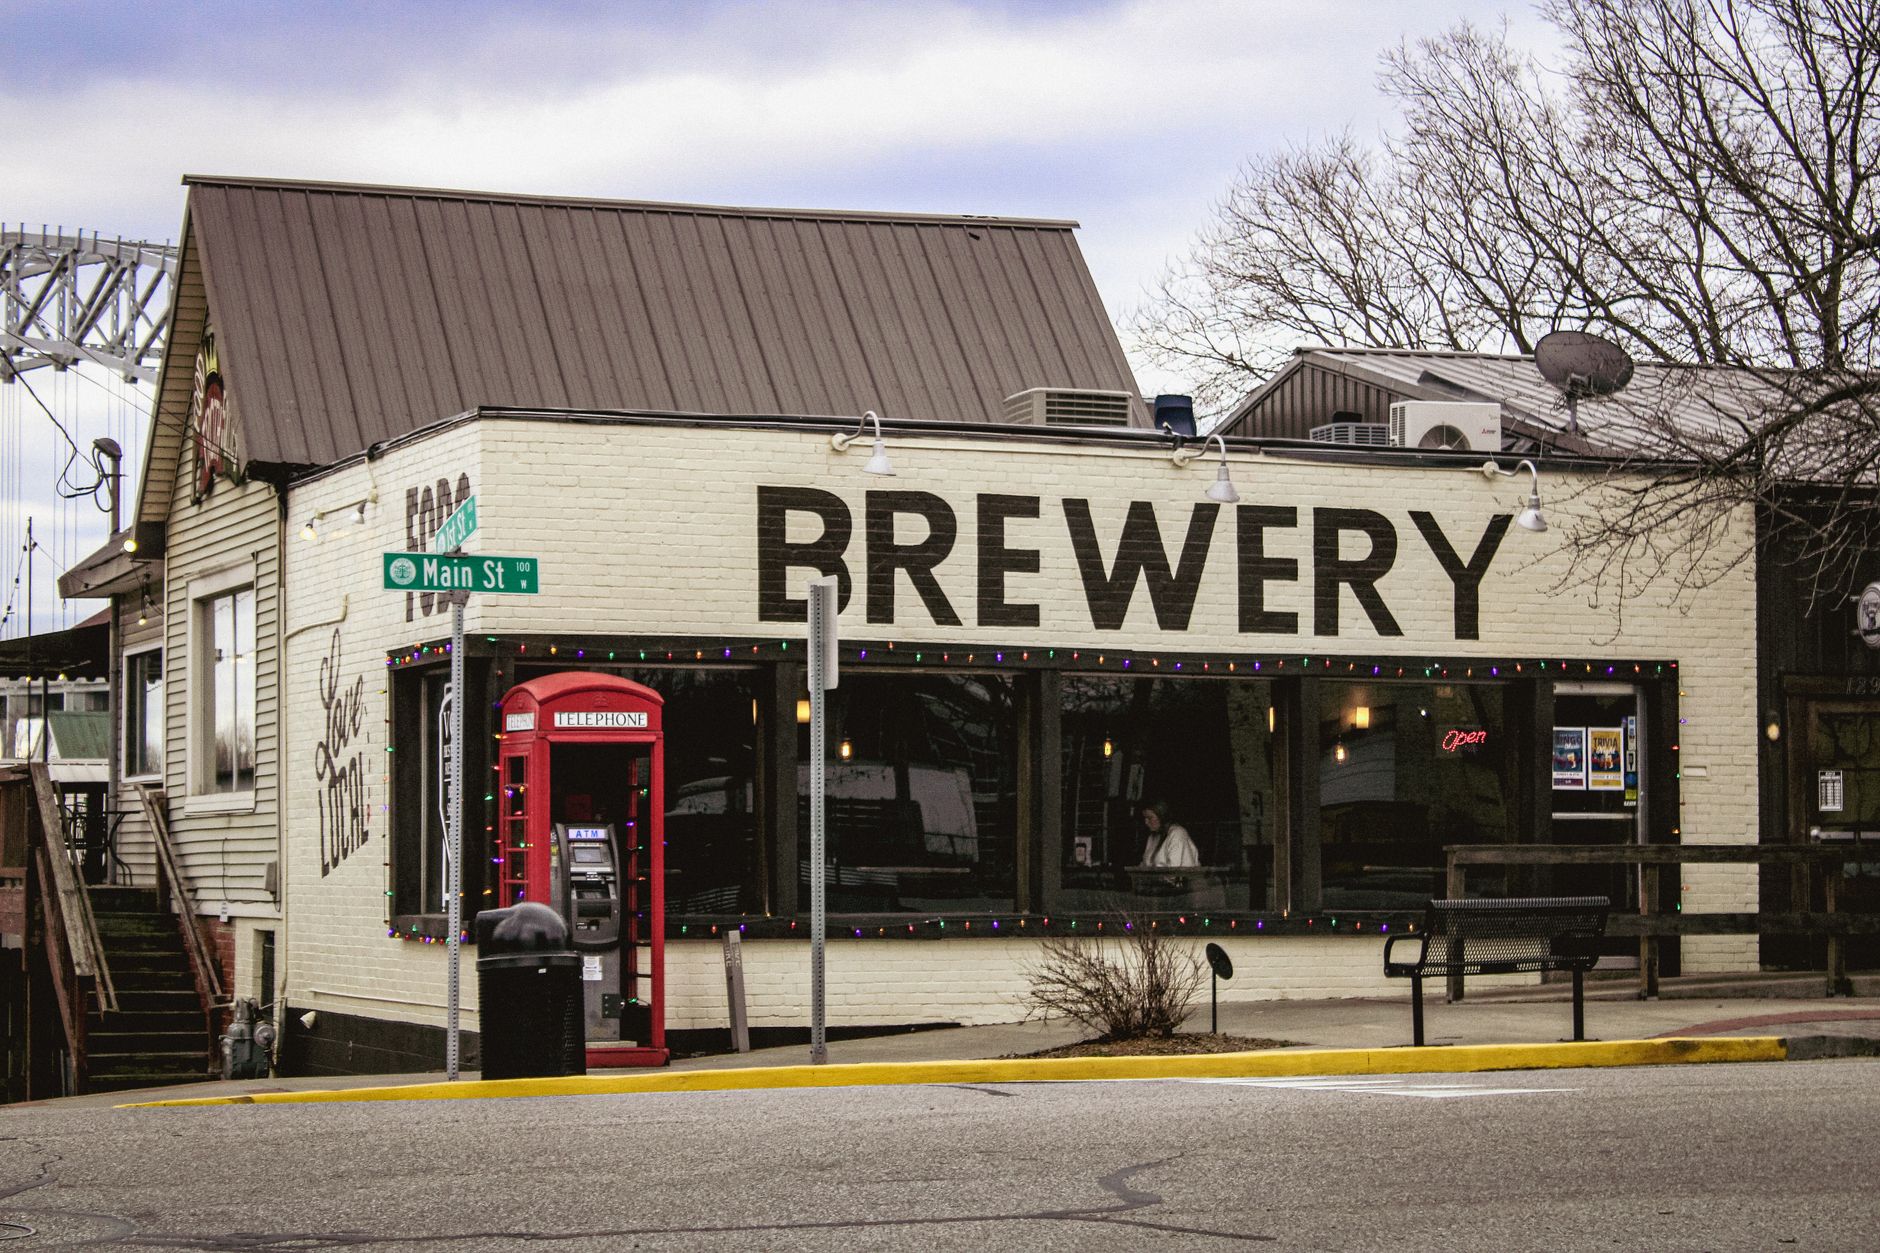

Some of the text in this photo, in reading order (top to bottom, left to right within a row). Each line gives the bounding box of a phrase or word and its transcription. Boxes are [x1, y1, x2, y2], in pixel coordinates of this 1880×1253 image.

[457, 511, 467, 540] St
[516, 562, 530, 572] 100
[757, 485, 1515, 640] BREWERY
[423, 558, 473, 588] Main
[483, 560, 504, 589] St
[521, 579, 527, 590] W
[557, 712, 647, 727] TELEPHONE
[1443, 729, 1486, 752] Open
[1593, 738, 1618, 748] TRIVIA
[318, 751, 369, 879] LOCAL
[575, 829, 600, 839] ATM
